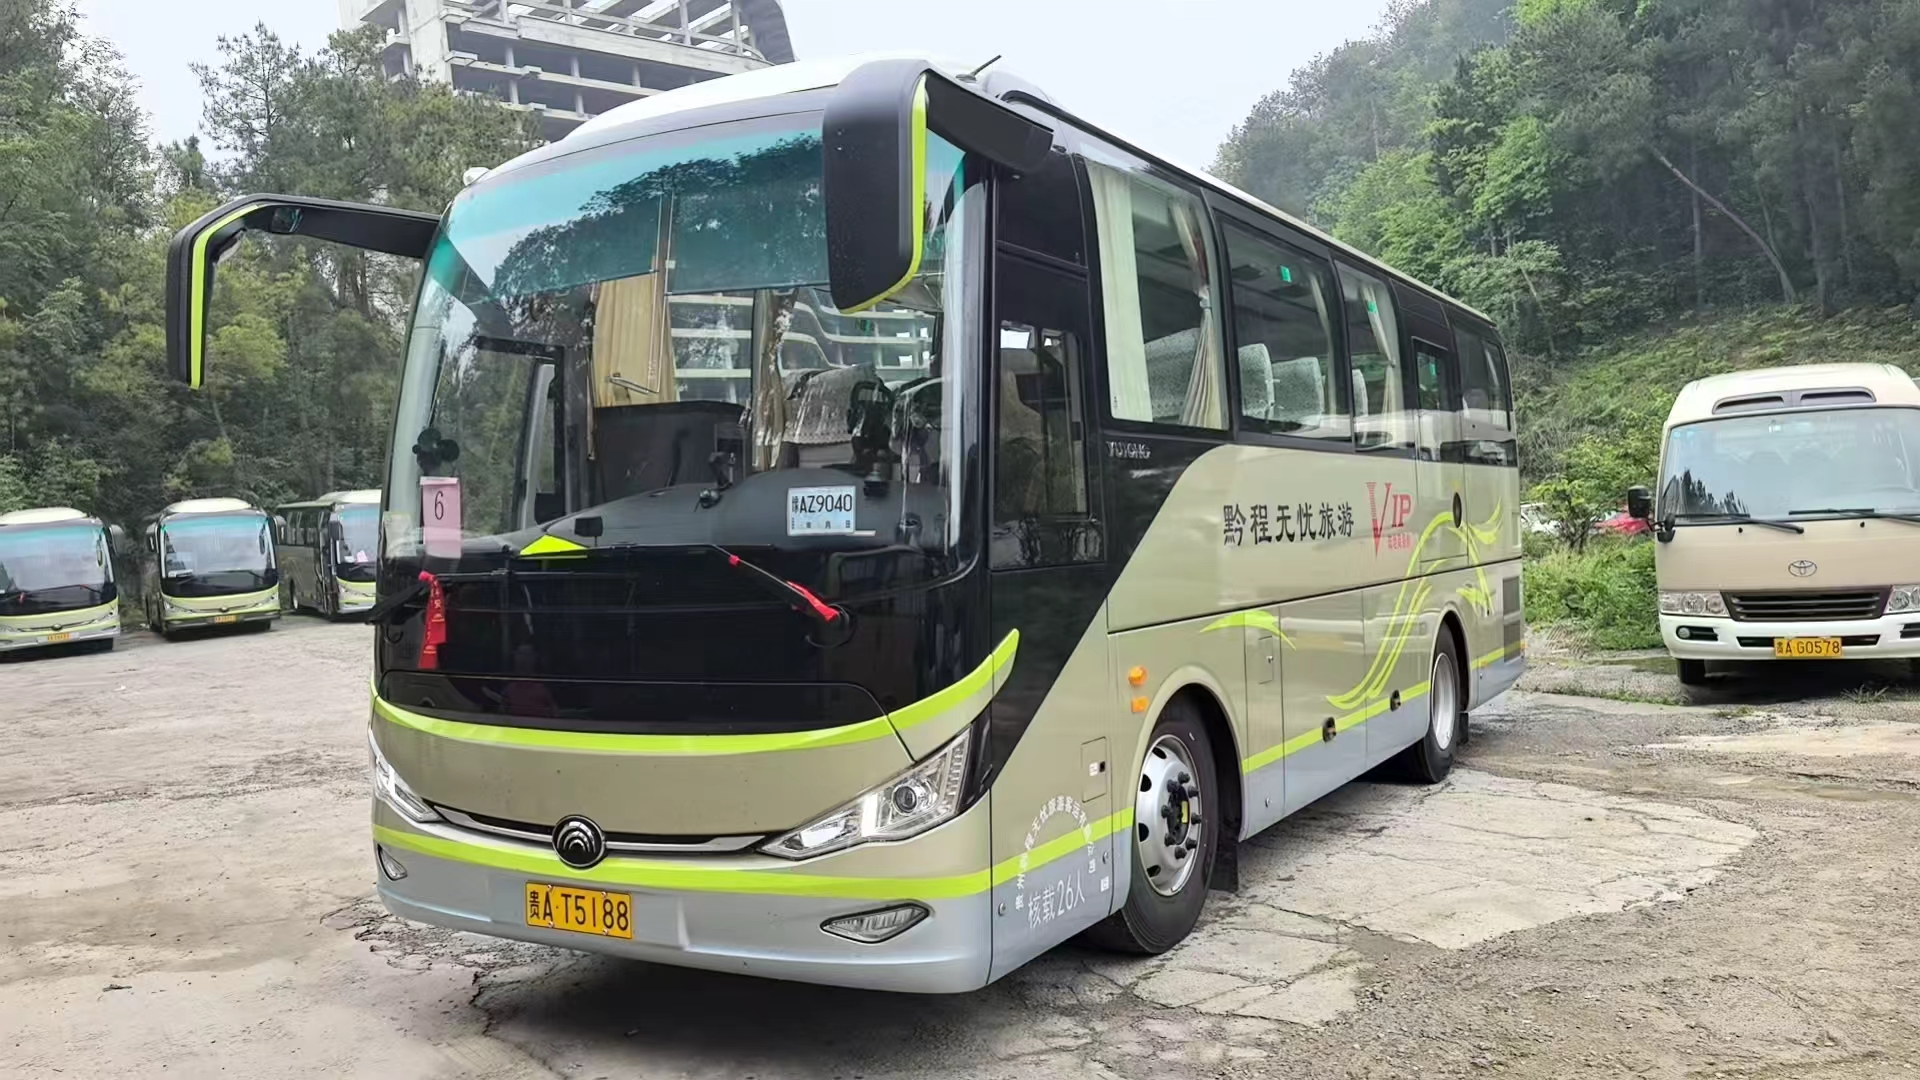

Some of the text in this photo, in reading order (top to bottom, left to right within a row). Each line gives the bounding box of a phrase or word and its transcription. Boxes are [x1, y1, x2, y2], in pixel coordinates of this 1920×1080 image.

[434, 490, 444, 520] 6
[1223, 501, 1355, 546] 黔程无忧旅游
[1365, 481, 1412, 559] VIP
[1028, 868, 1085, 929] 核载26人
